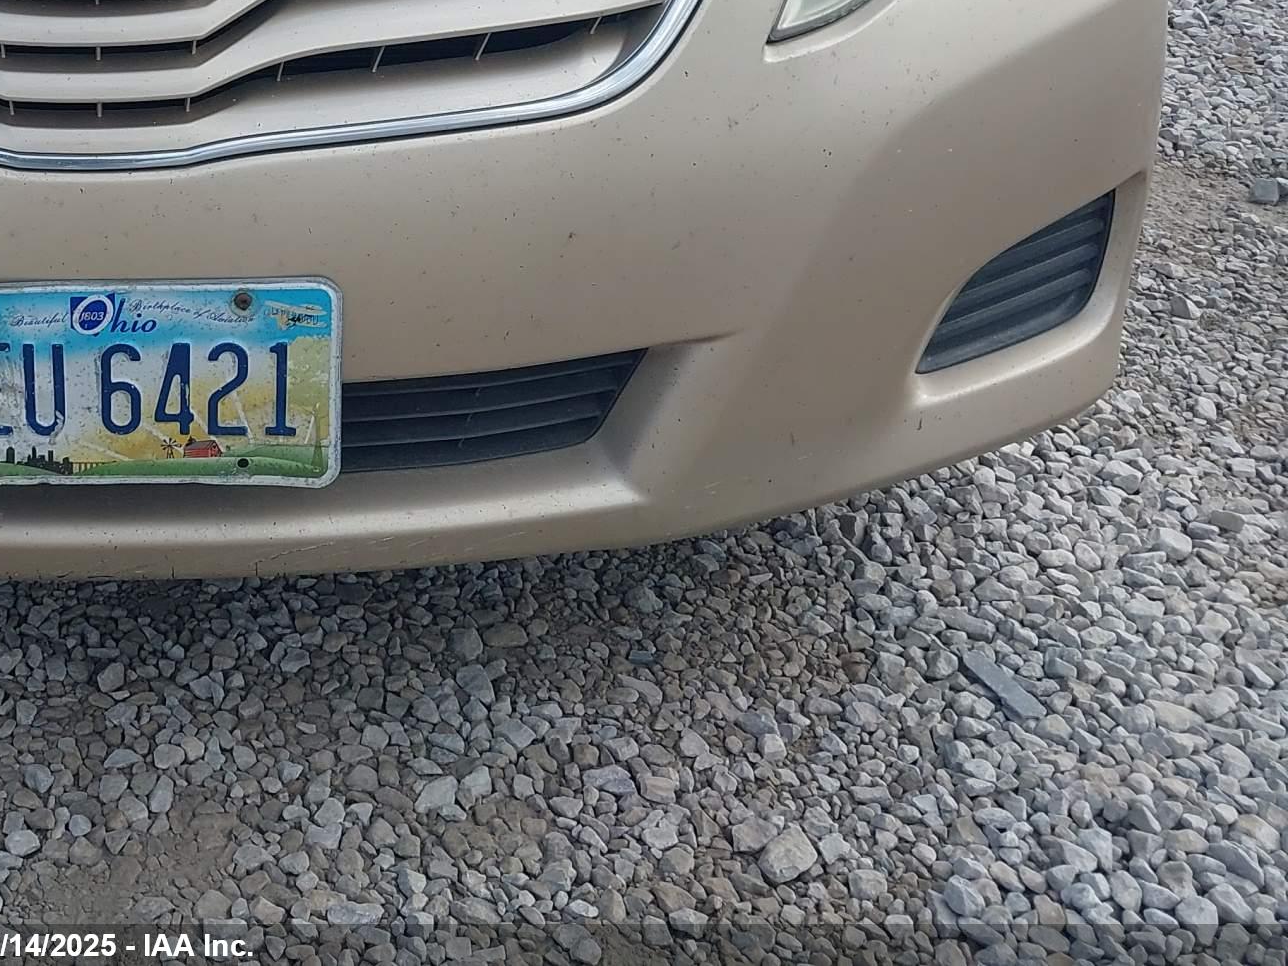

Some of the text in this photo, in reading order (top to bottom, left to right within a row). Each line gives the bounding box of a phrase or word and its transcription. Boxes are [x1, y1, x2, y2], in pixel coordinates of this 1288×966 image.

[9, 312, 69, 328] Beautiful
[72, 294, 158, 336] Ohio
[128, 298, 191, 314] Birthplace
[99, 341, 297, 437] 6421
